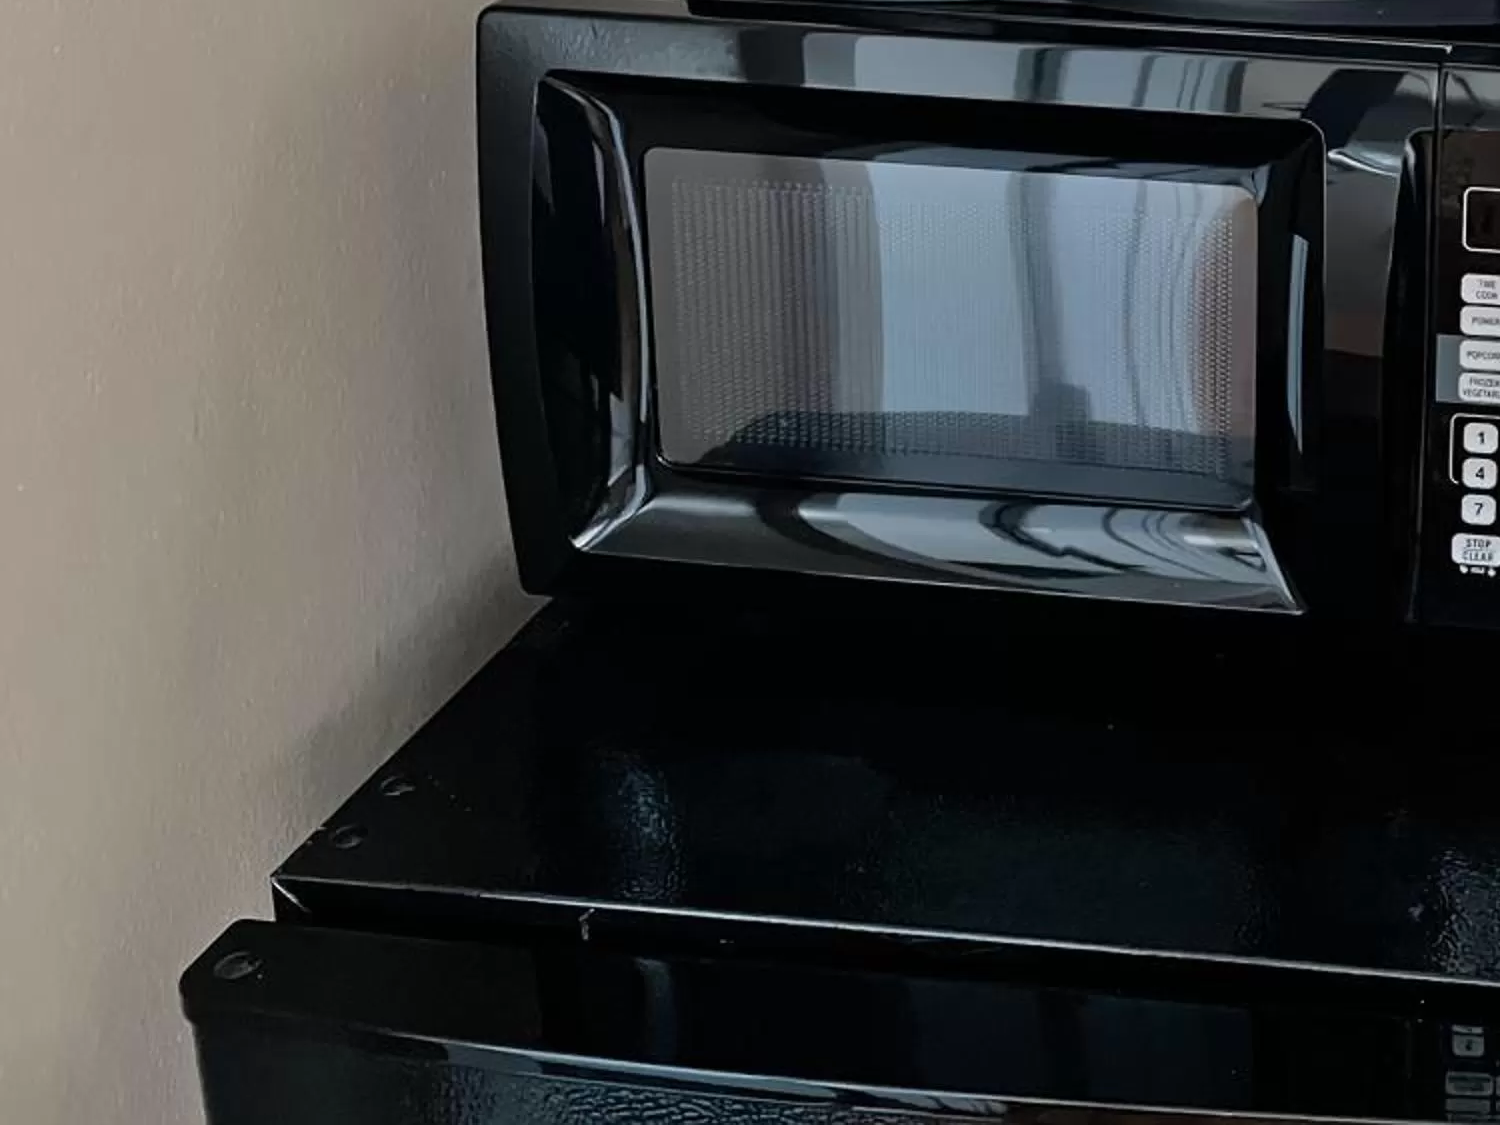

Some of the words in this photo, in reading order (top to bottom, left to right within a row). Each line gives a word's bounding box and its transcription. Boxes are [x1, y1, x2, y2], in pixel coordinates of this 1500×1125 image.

[1471, 316, 1500, 325] POWER
[1477, 431, 1485, 445] 1
[1475, 466, 1485, 480] 4
[1474, 502, 1484, 516] 7
[1465, 538, 1492, 548] STOP
[1462, 550, 1494, 562] CLEAR
